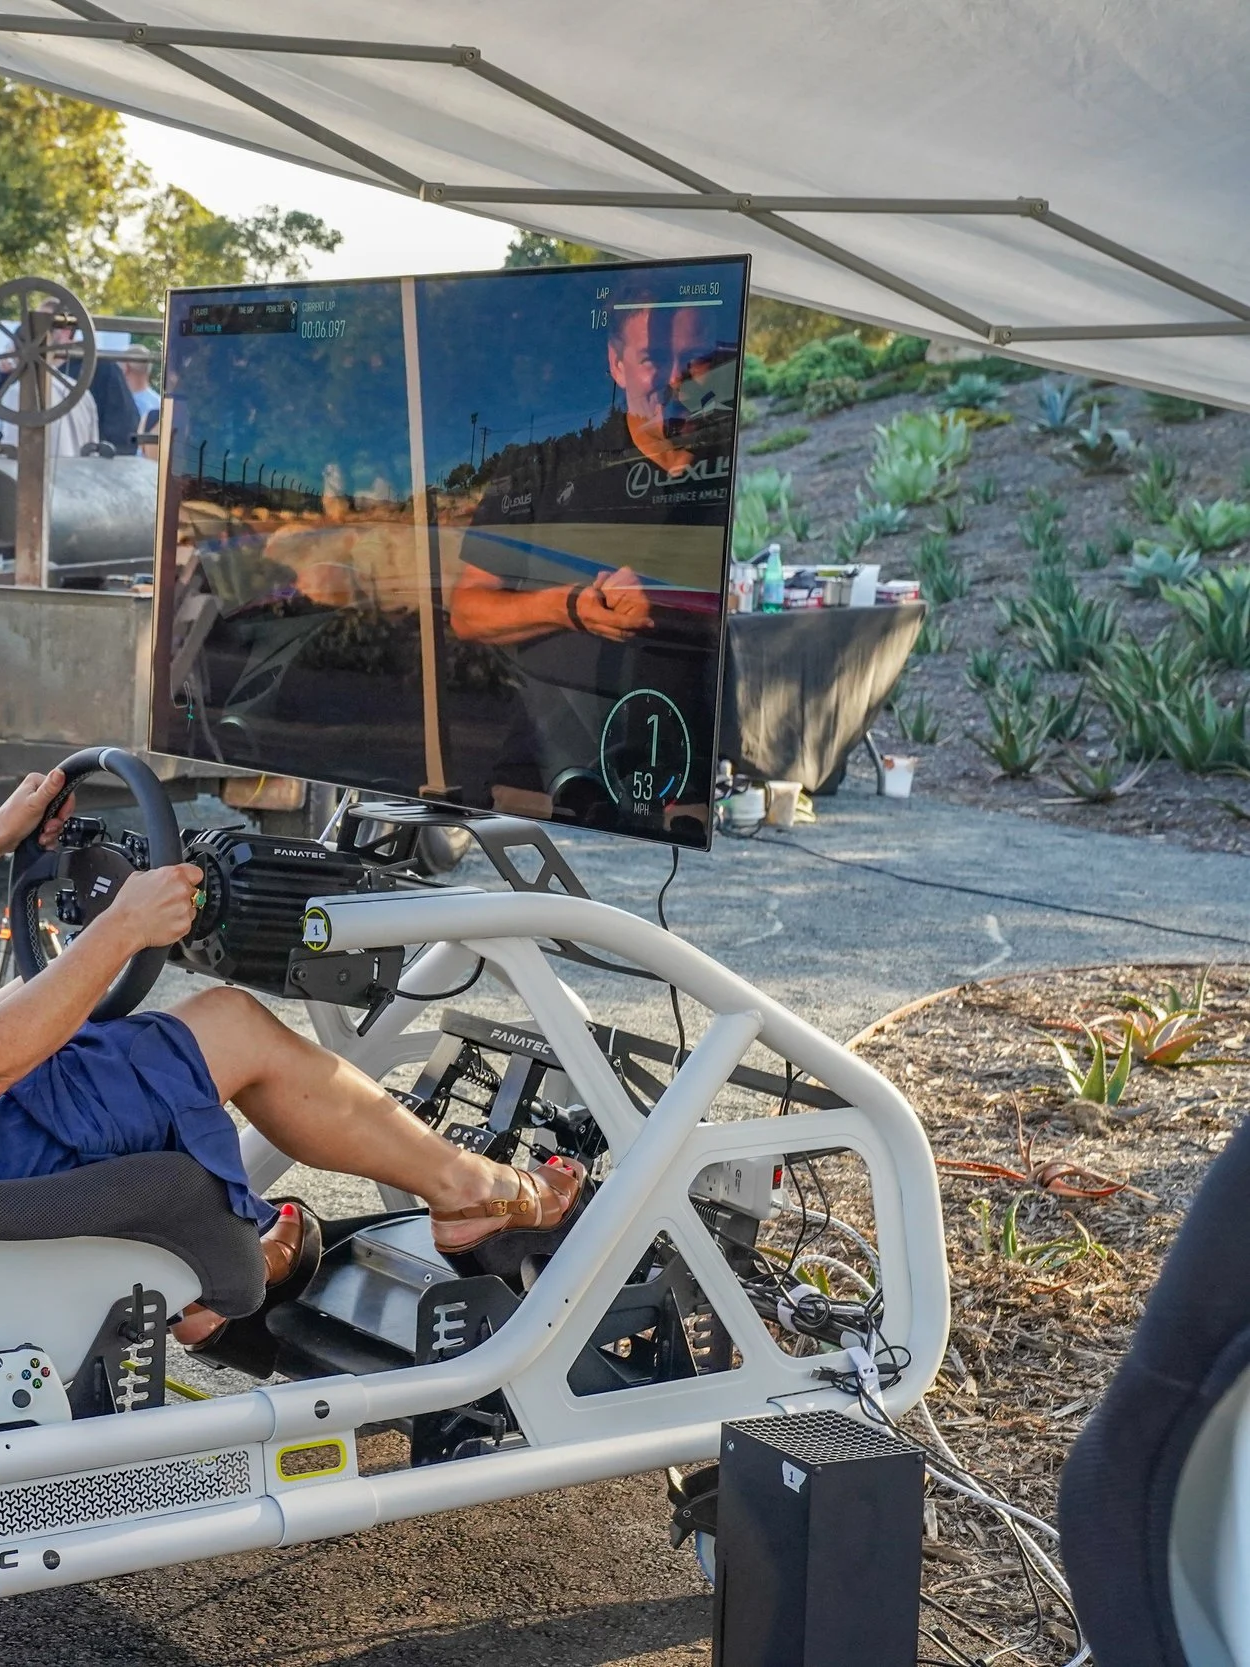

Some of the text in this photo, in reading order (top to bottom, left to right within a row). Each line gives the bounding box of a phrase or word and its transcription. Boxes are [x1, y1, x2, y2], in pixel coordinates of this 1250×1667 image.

[596, 287, 610, 300] LAP
[679, 281, 720, 296] CAR LEVEL 50
[301, 300, 336, 313] CURRENT LAP
[590, 308, 608, 330] 1/3
[301, 319, 346, 339] 00:06.097
[651, 490, 696, 505] EXPERIENCE
[646, 713, 659, 768] 1
[632, 771, 653, 801] 53
[633, 802, 649, 816] MPH
[274, 848, 327, 860] FANATEC
[313, 924, 320, 936] 1
[490, 1028, 552, 1054] FANATEC
[788, 1471, 795, 1483] 1
